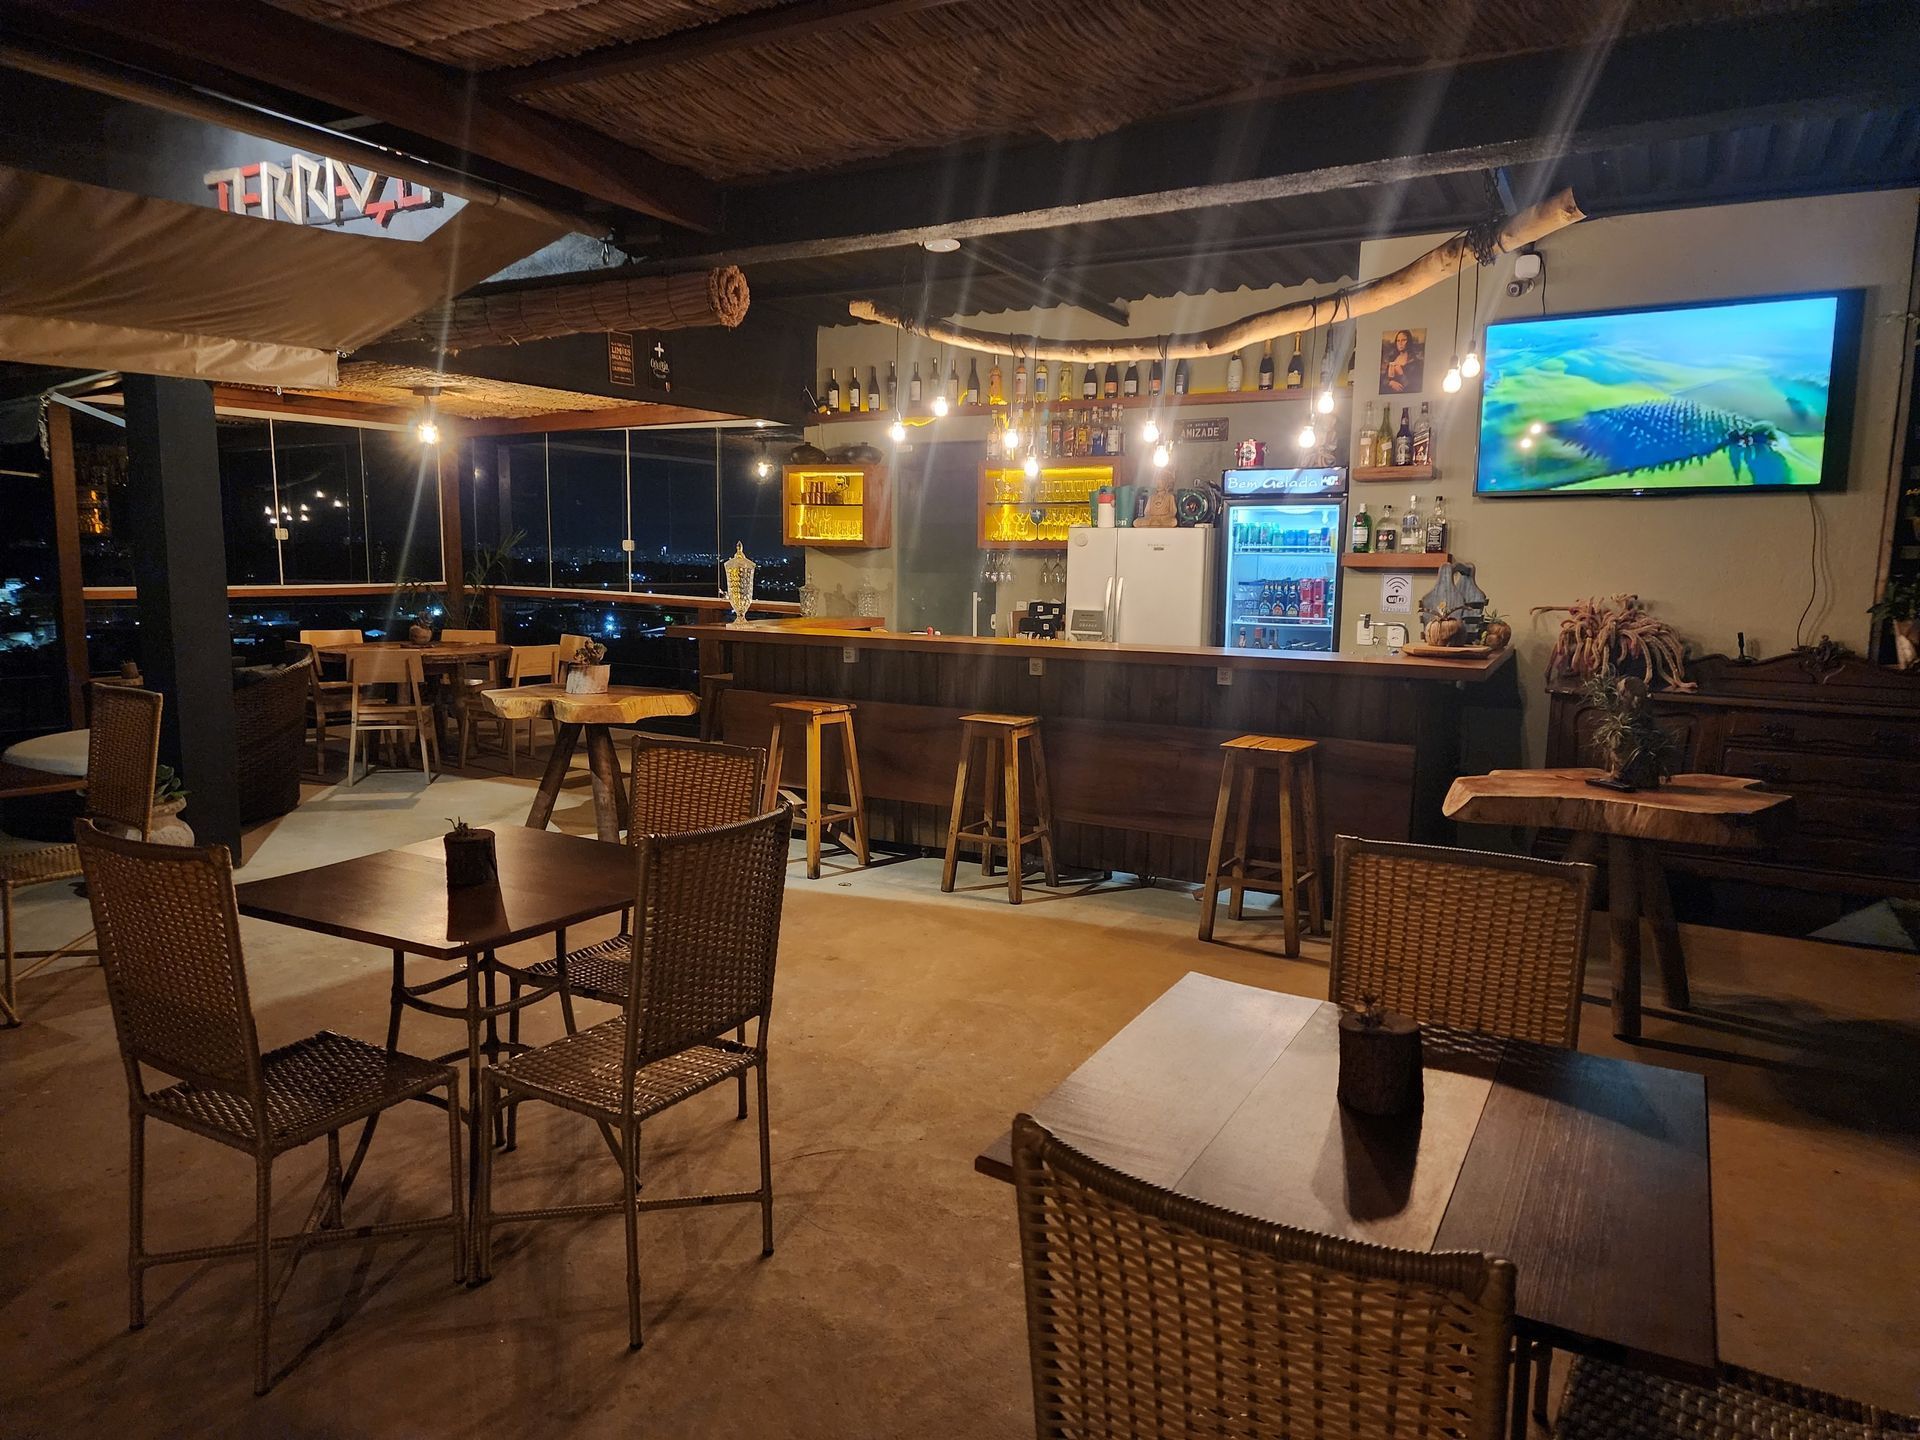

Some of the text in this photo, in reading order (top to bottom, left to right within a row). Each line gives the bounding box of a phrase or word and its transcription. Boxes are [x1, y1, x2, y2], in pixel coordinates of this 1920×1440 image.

[1181, 427, 1219, 438] AMIZADE
[1228, 477, 1257, 489] Bem
[1263, 476, 1318, 489] Gelada
